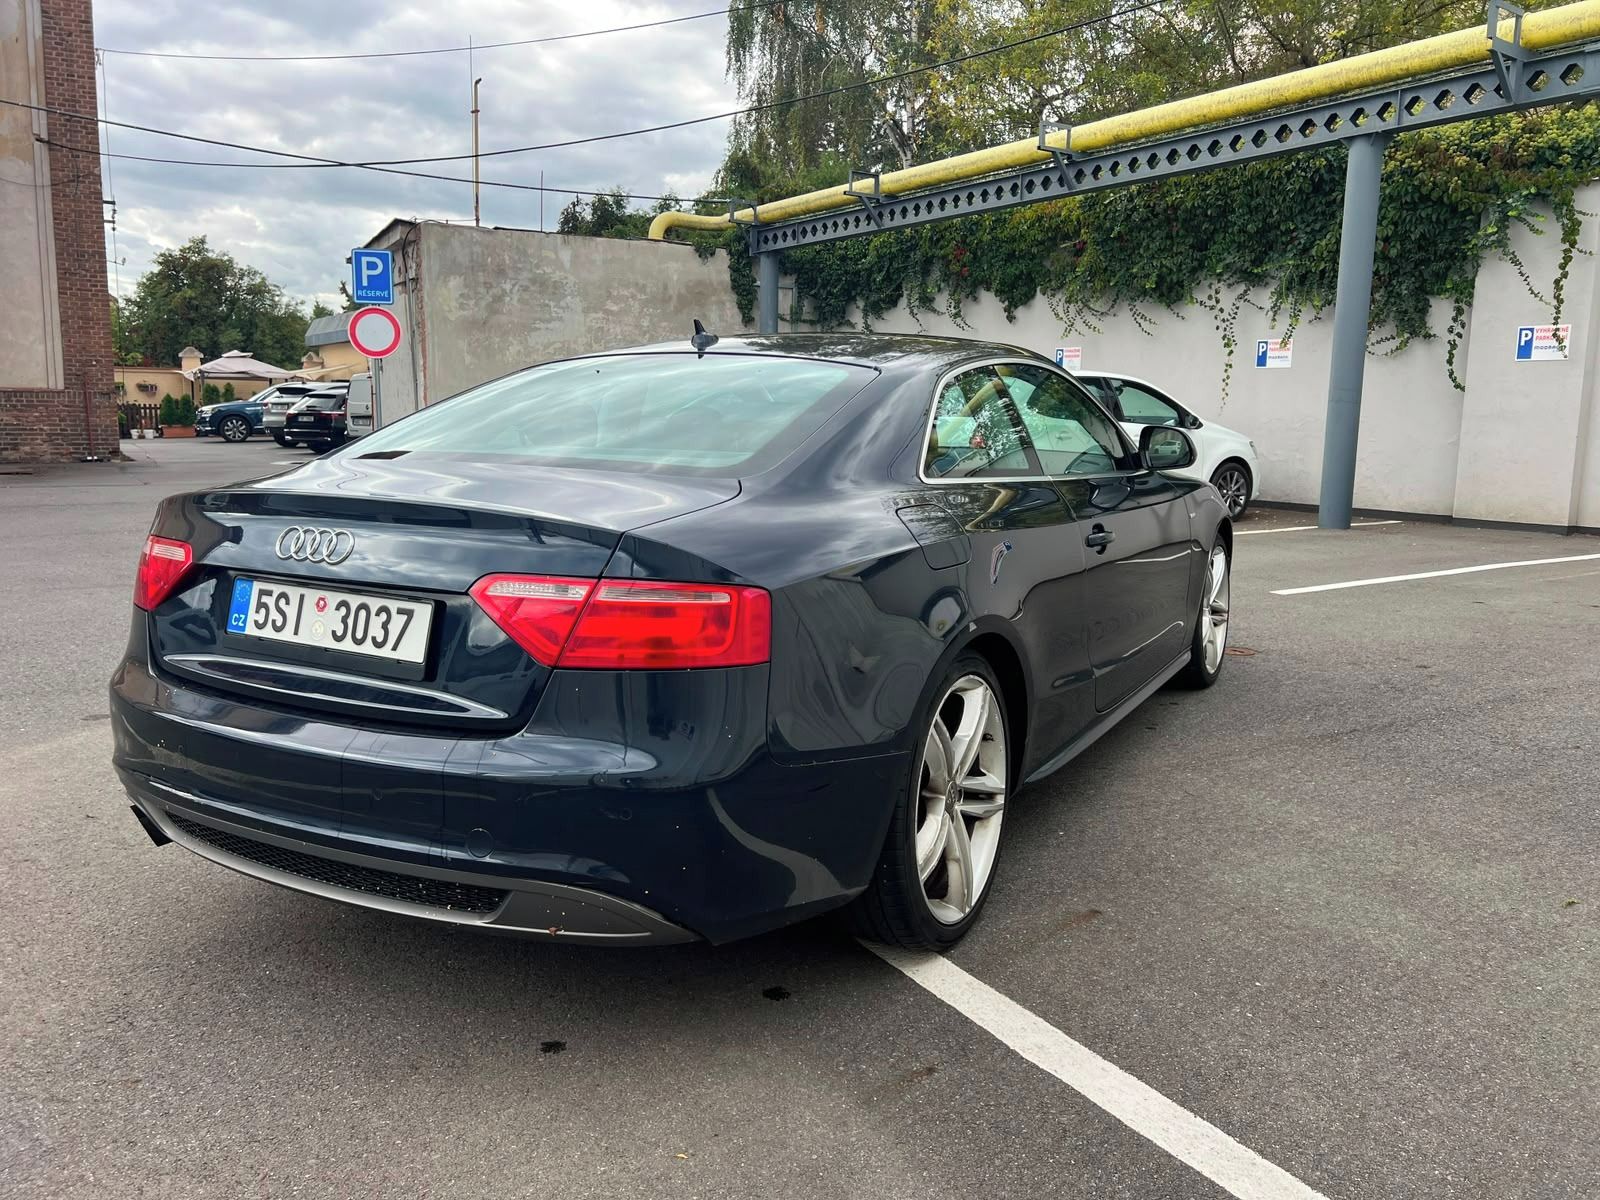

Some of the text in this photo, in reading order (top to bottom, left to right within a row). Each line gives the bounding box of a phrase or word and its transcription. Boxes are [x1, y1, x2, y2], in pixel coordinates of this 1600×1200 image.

[361, 256, 384, 287] P
[1520, 330, 1533, 346] P
[1056, 350, 1063, 362] P
[1258, 342, 1267, 356] P
[231, 613, 245, 627] CZ
[253, 588, 415, 652] 5SI 3037
